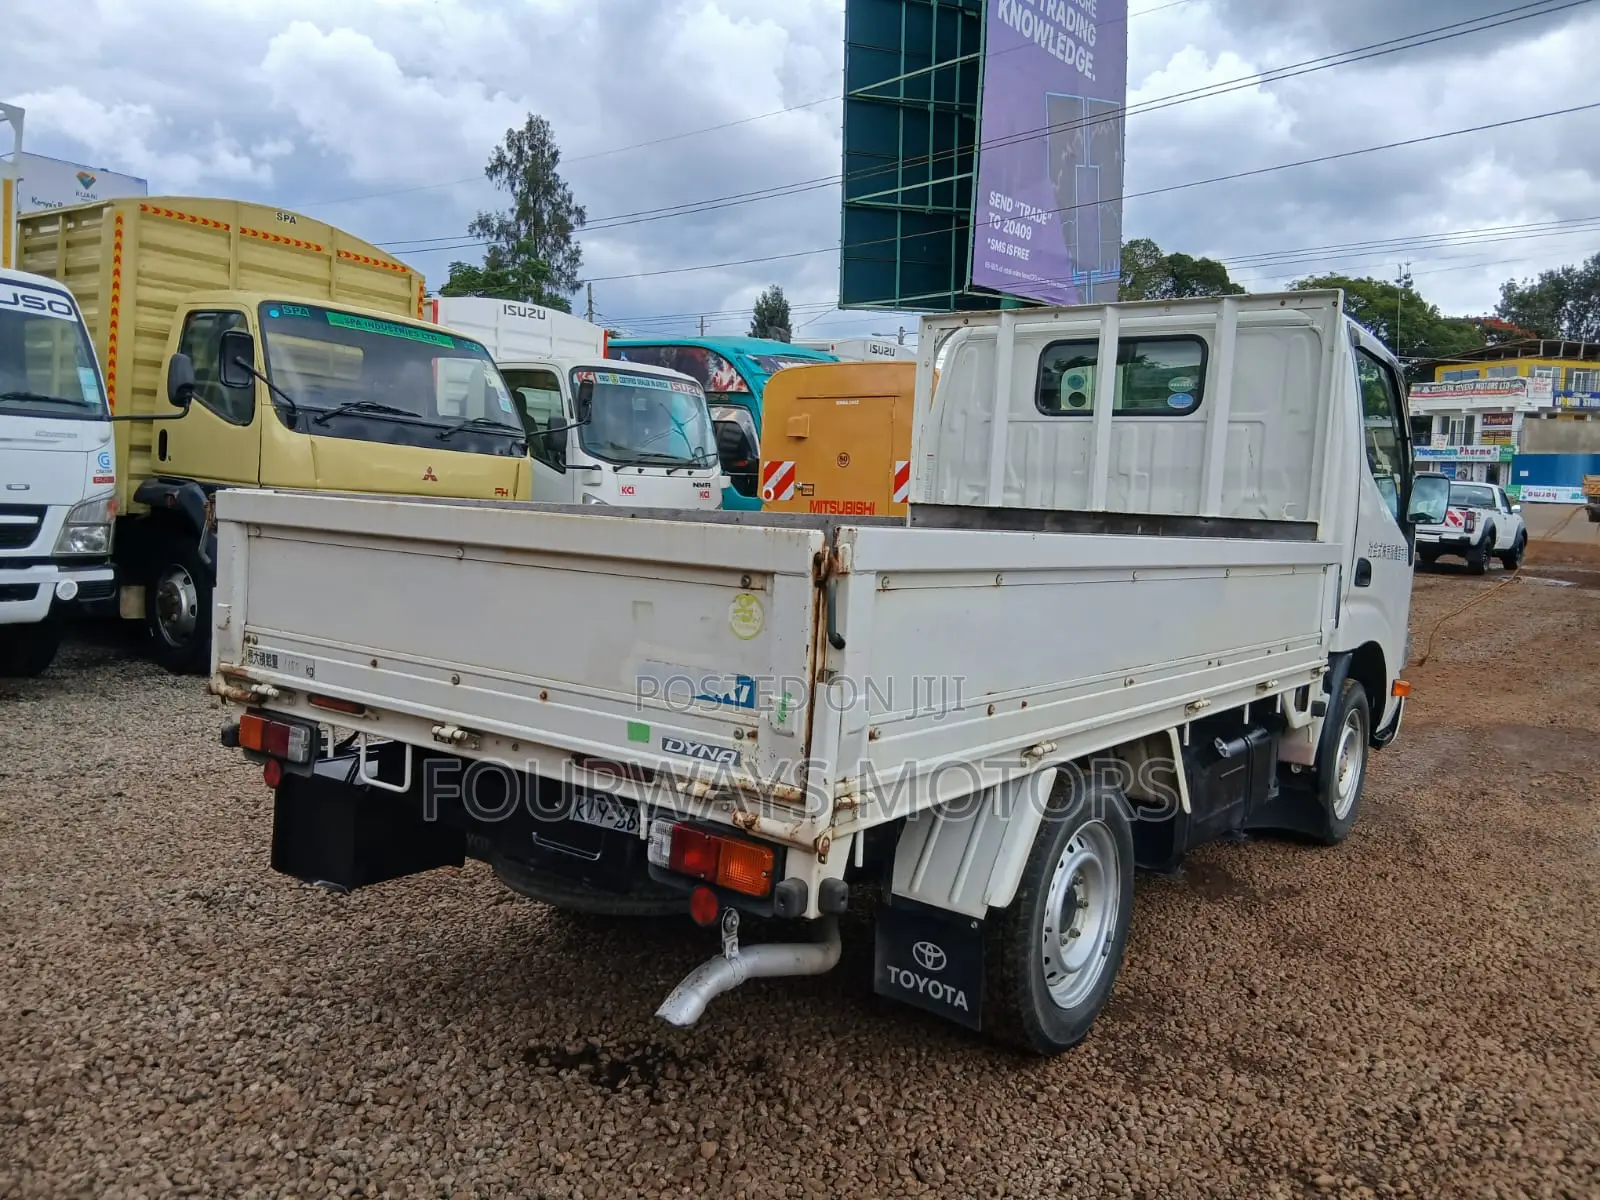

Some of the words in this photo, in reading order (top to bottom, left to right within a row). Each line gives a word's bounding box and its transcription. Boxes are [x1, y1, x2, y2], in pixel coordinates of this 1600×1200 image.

[998, 0, 1096, 81] KNOWLEDGE.
[989, 191, 1013, 212] SEND
[276, 212, 296, 224] SPA
[989, 211, 1000, 229] TO
[1003, 219, 1031, 240] 20409
[1006, 243, 1013, 255] IS
[1013, 246, 1030, 260] FREE
[284, 305, 308, 316] SPA
[503, 303, 546, 320] ISUZU
[869, 344, 895, 357] ISUZU
[1459, 446, 1491, 455] Pharma
[621, 486, 635, 495] KCI
[809, 500, 875, 515] MITSUBISHI
[306, 664, 314, 678] kg
[665, 740, 738, 765] DYNA
[887, 964, 968, 1012] TOYOTA
